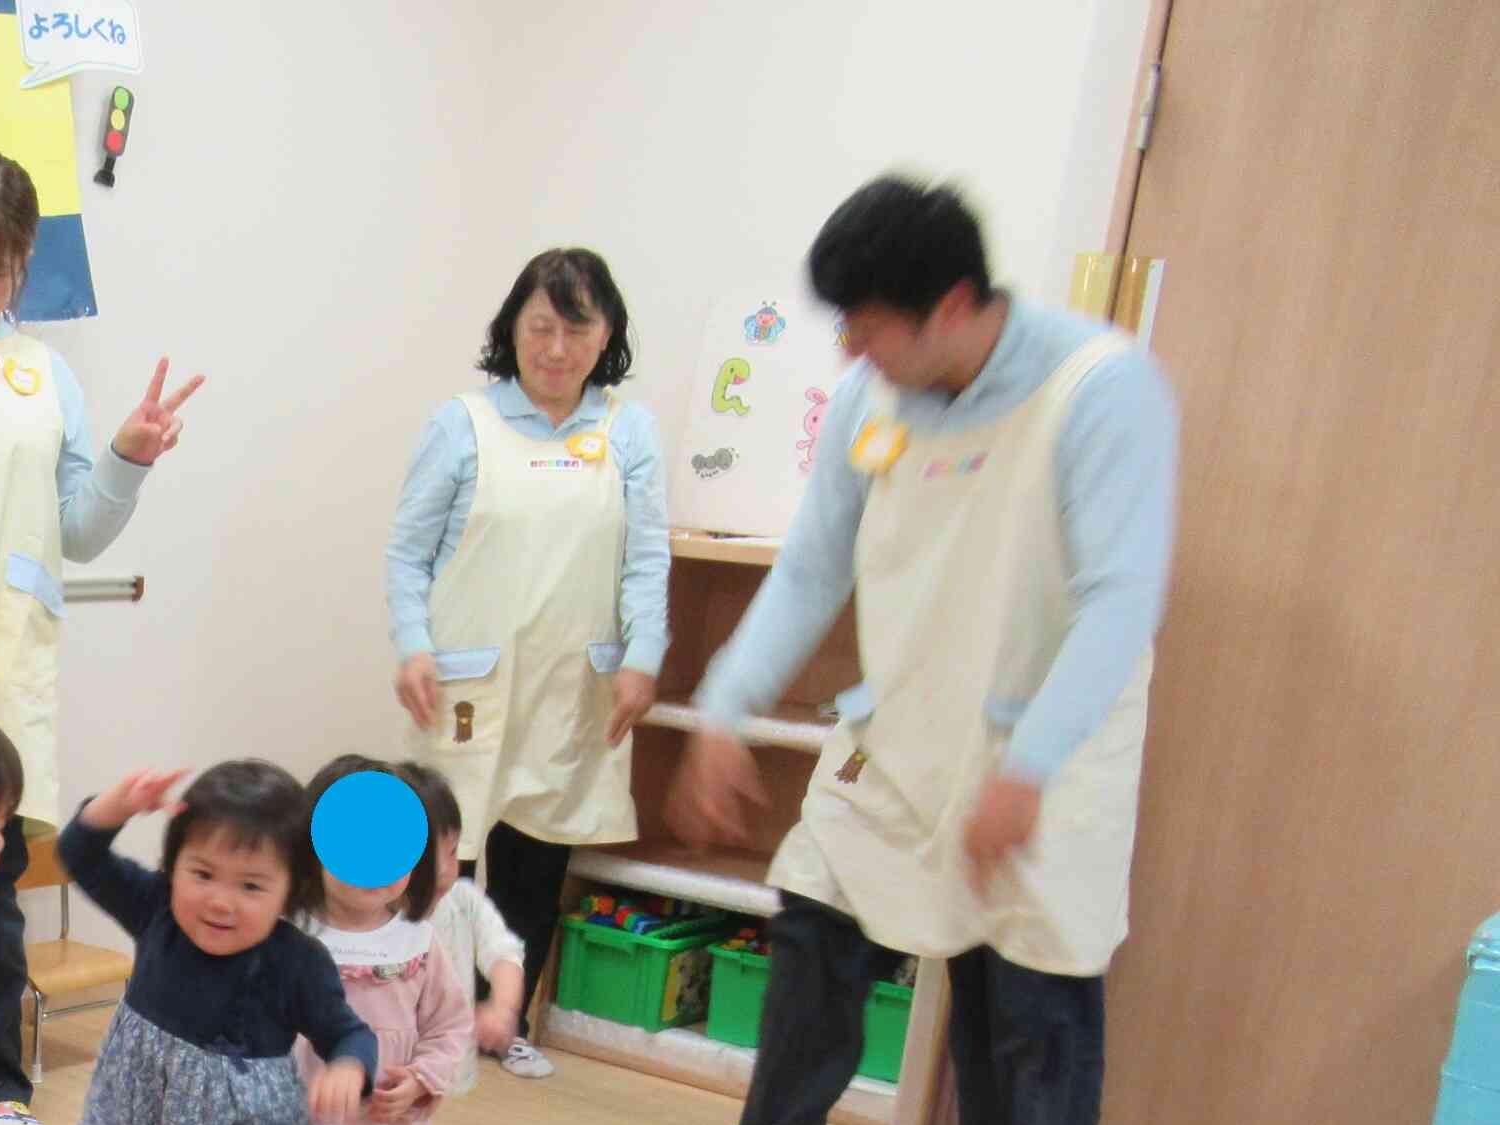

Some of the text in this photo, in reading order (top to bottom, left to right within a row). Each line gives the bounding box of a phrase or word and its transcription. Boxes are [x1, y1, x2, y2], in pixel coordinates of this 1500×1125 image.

[28, 12, 127, 45] よろしくね
